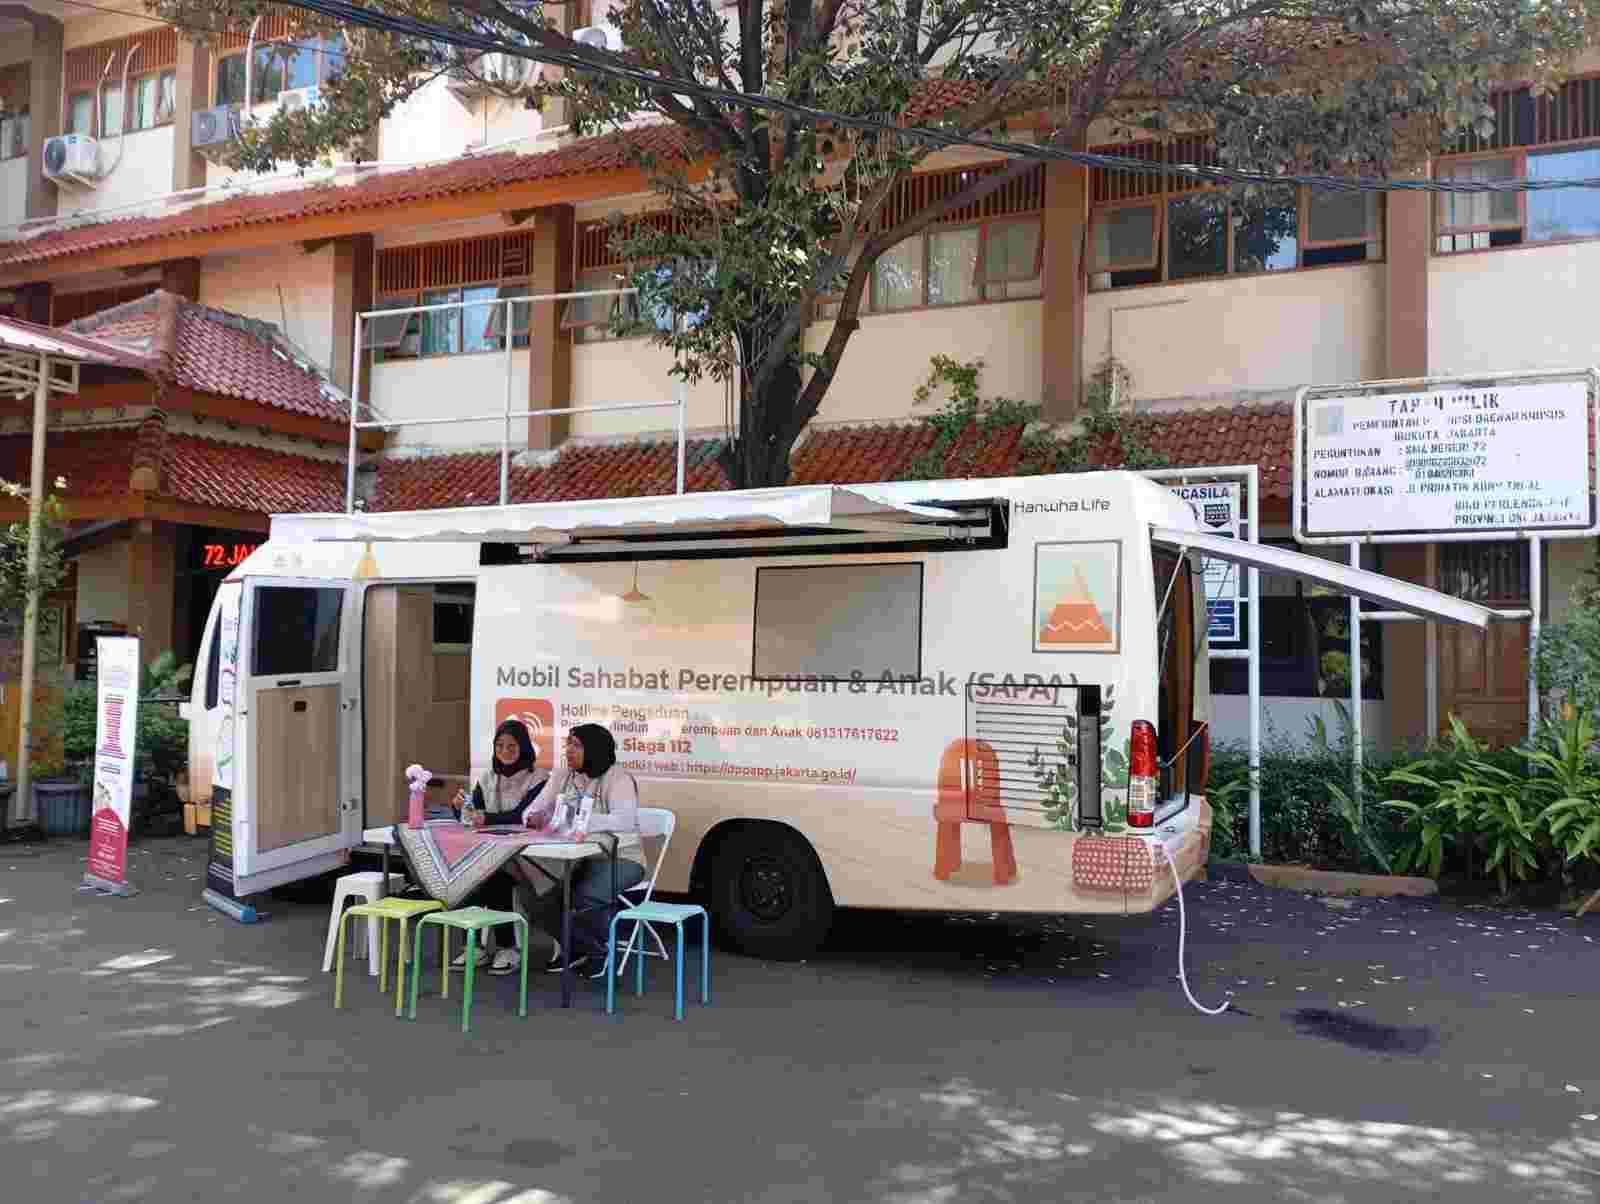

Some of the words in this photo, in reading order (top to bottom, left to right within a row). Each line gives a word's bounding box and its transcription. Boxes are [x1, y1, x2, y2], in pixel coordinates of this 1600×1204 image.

[204, 545, 225, 566] 72
[496, 665, 561, 689] Mobil
[567, 667, 670, 691] Sahabat
[678, 669, 839, 700] Perempuan
[847, 669, 868, 694] &
[876, 668, 957, 696] Anak
[623, 737, 666, 754] Siaga
